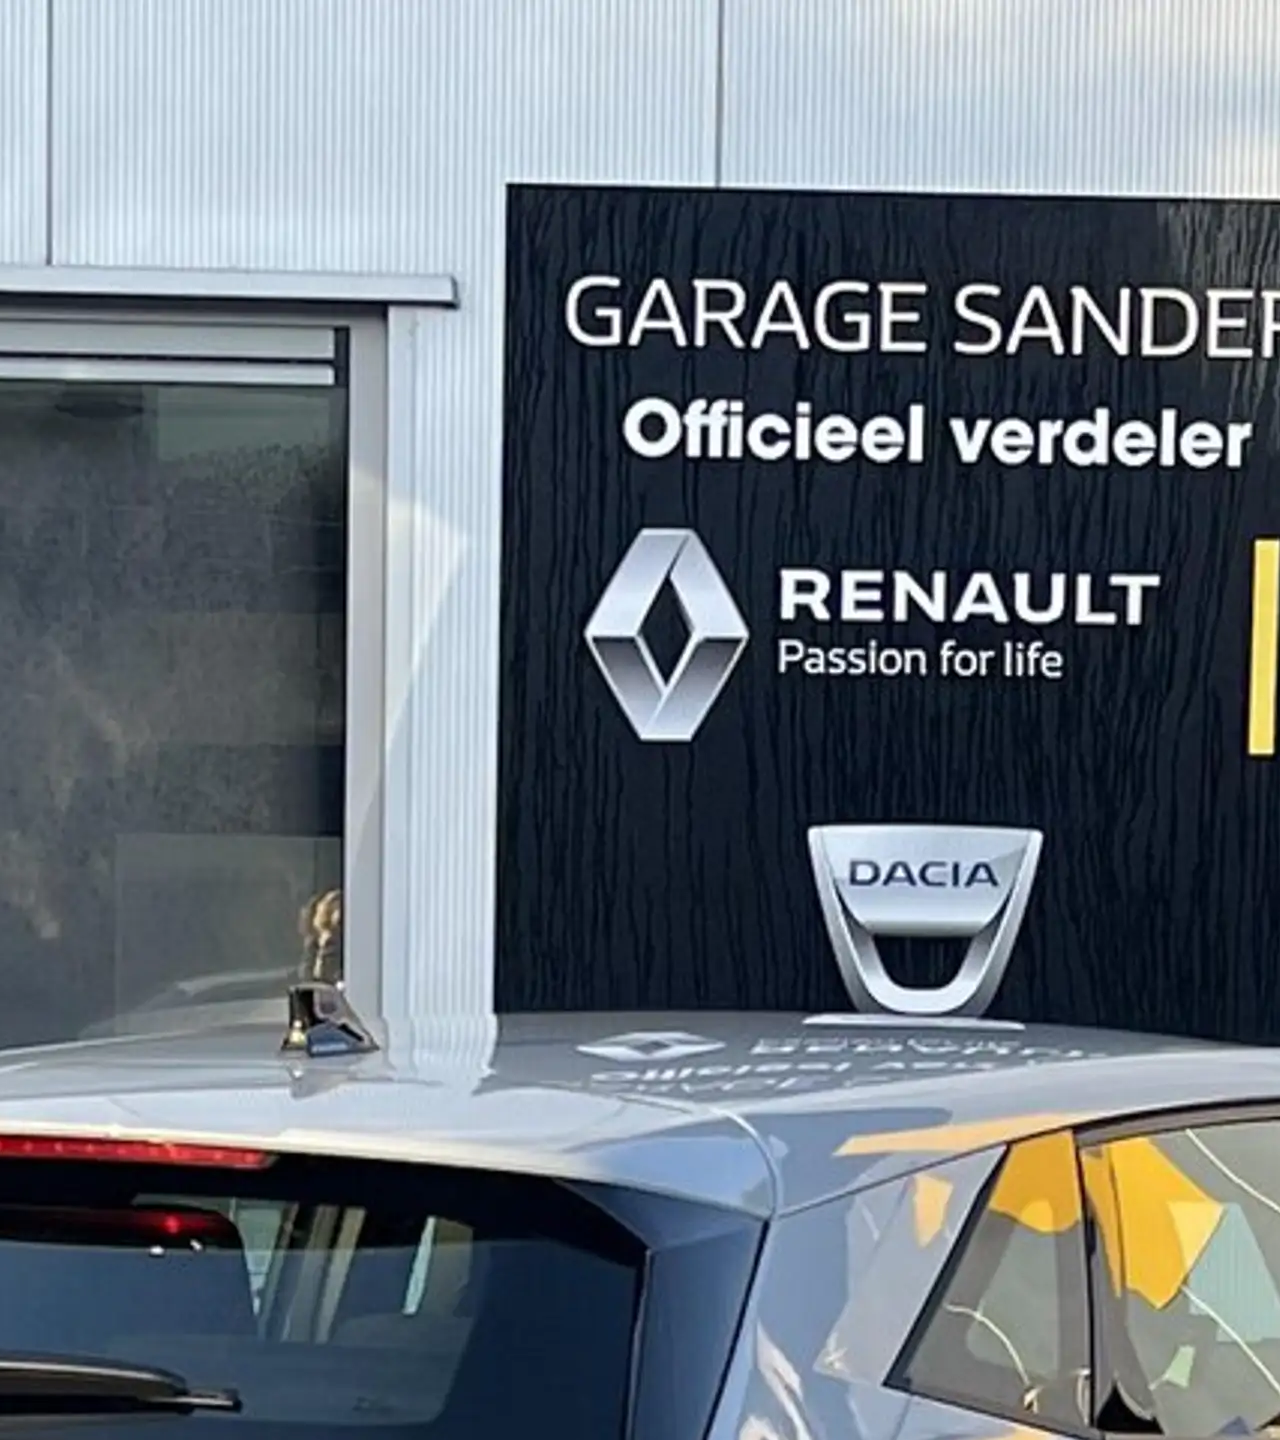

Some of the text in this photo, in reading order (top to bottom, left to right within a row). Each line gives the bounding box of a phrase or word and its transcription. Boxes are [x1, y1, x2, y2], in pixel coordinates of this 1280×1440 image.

[565, 274, 927, 353] GARAGE
[622, 397, 1254, 468] Officieel verdeler
[779, 568, 1161, 626] RENAULT
[778, 639, 1064, 679] Passion for life
[848, 858, 1000, 889] DACIA
